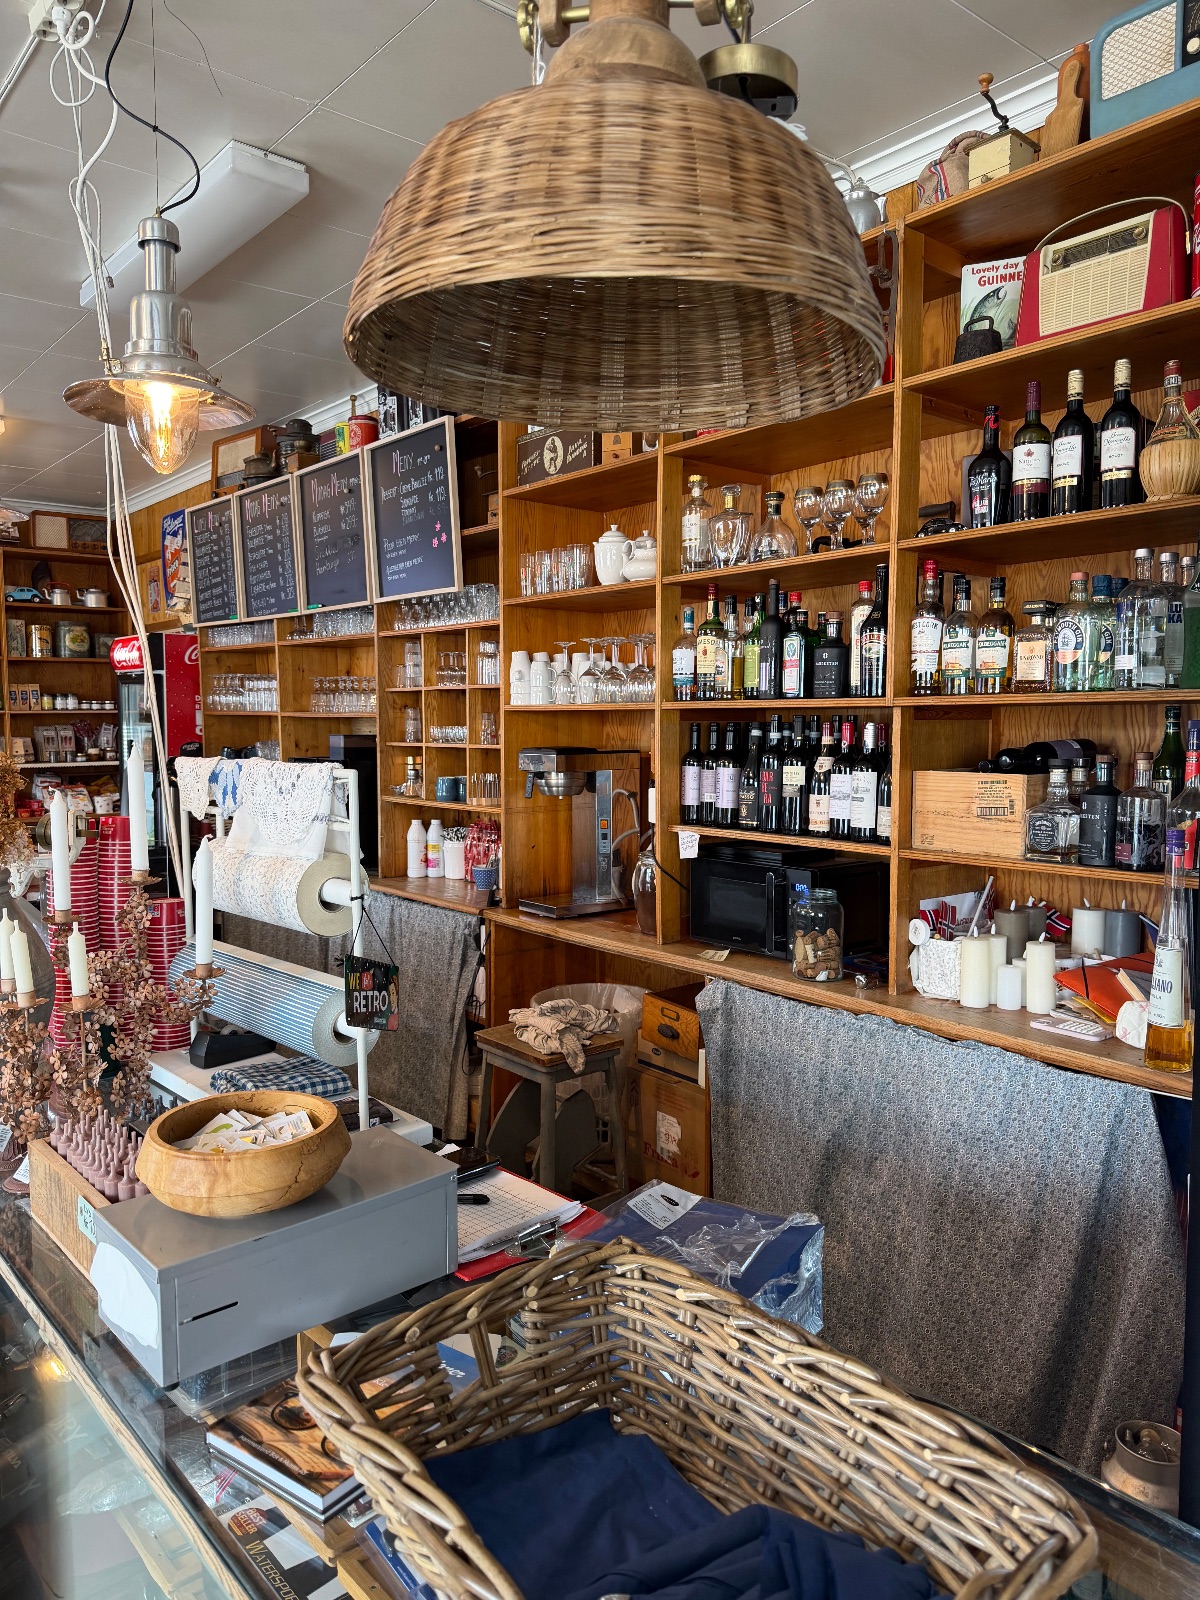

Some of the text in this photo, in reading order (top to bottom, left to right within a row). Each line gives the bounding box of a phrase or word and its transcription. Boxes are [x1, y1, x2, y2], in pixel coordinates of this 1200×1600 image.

[971, 262, 1019, 275] Lovely day
[977, 271, 1023, 287] GUINNE
[1053, 621, 1083, 644] PLYMOUTH GIN
[348, 972, 360, 989] WE
[353, 990, 389, 1012] RETRO
[235, 1511, 258, 1535] SELLER
[246, 1507, 267, 1525] BEST
